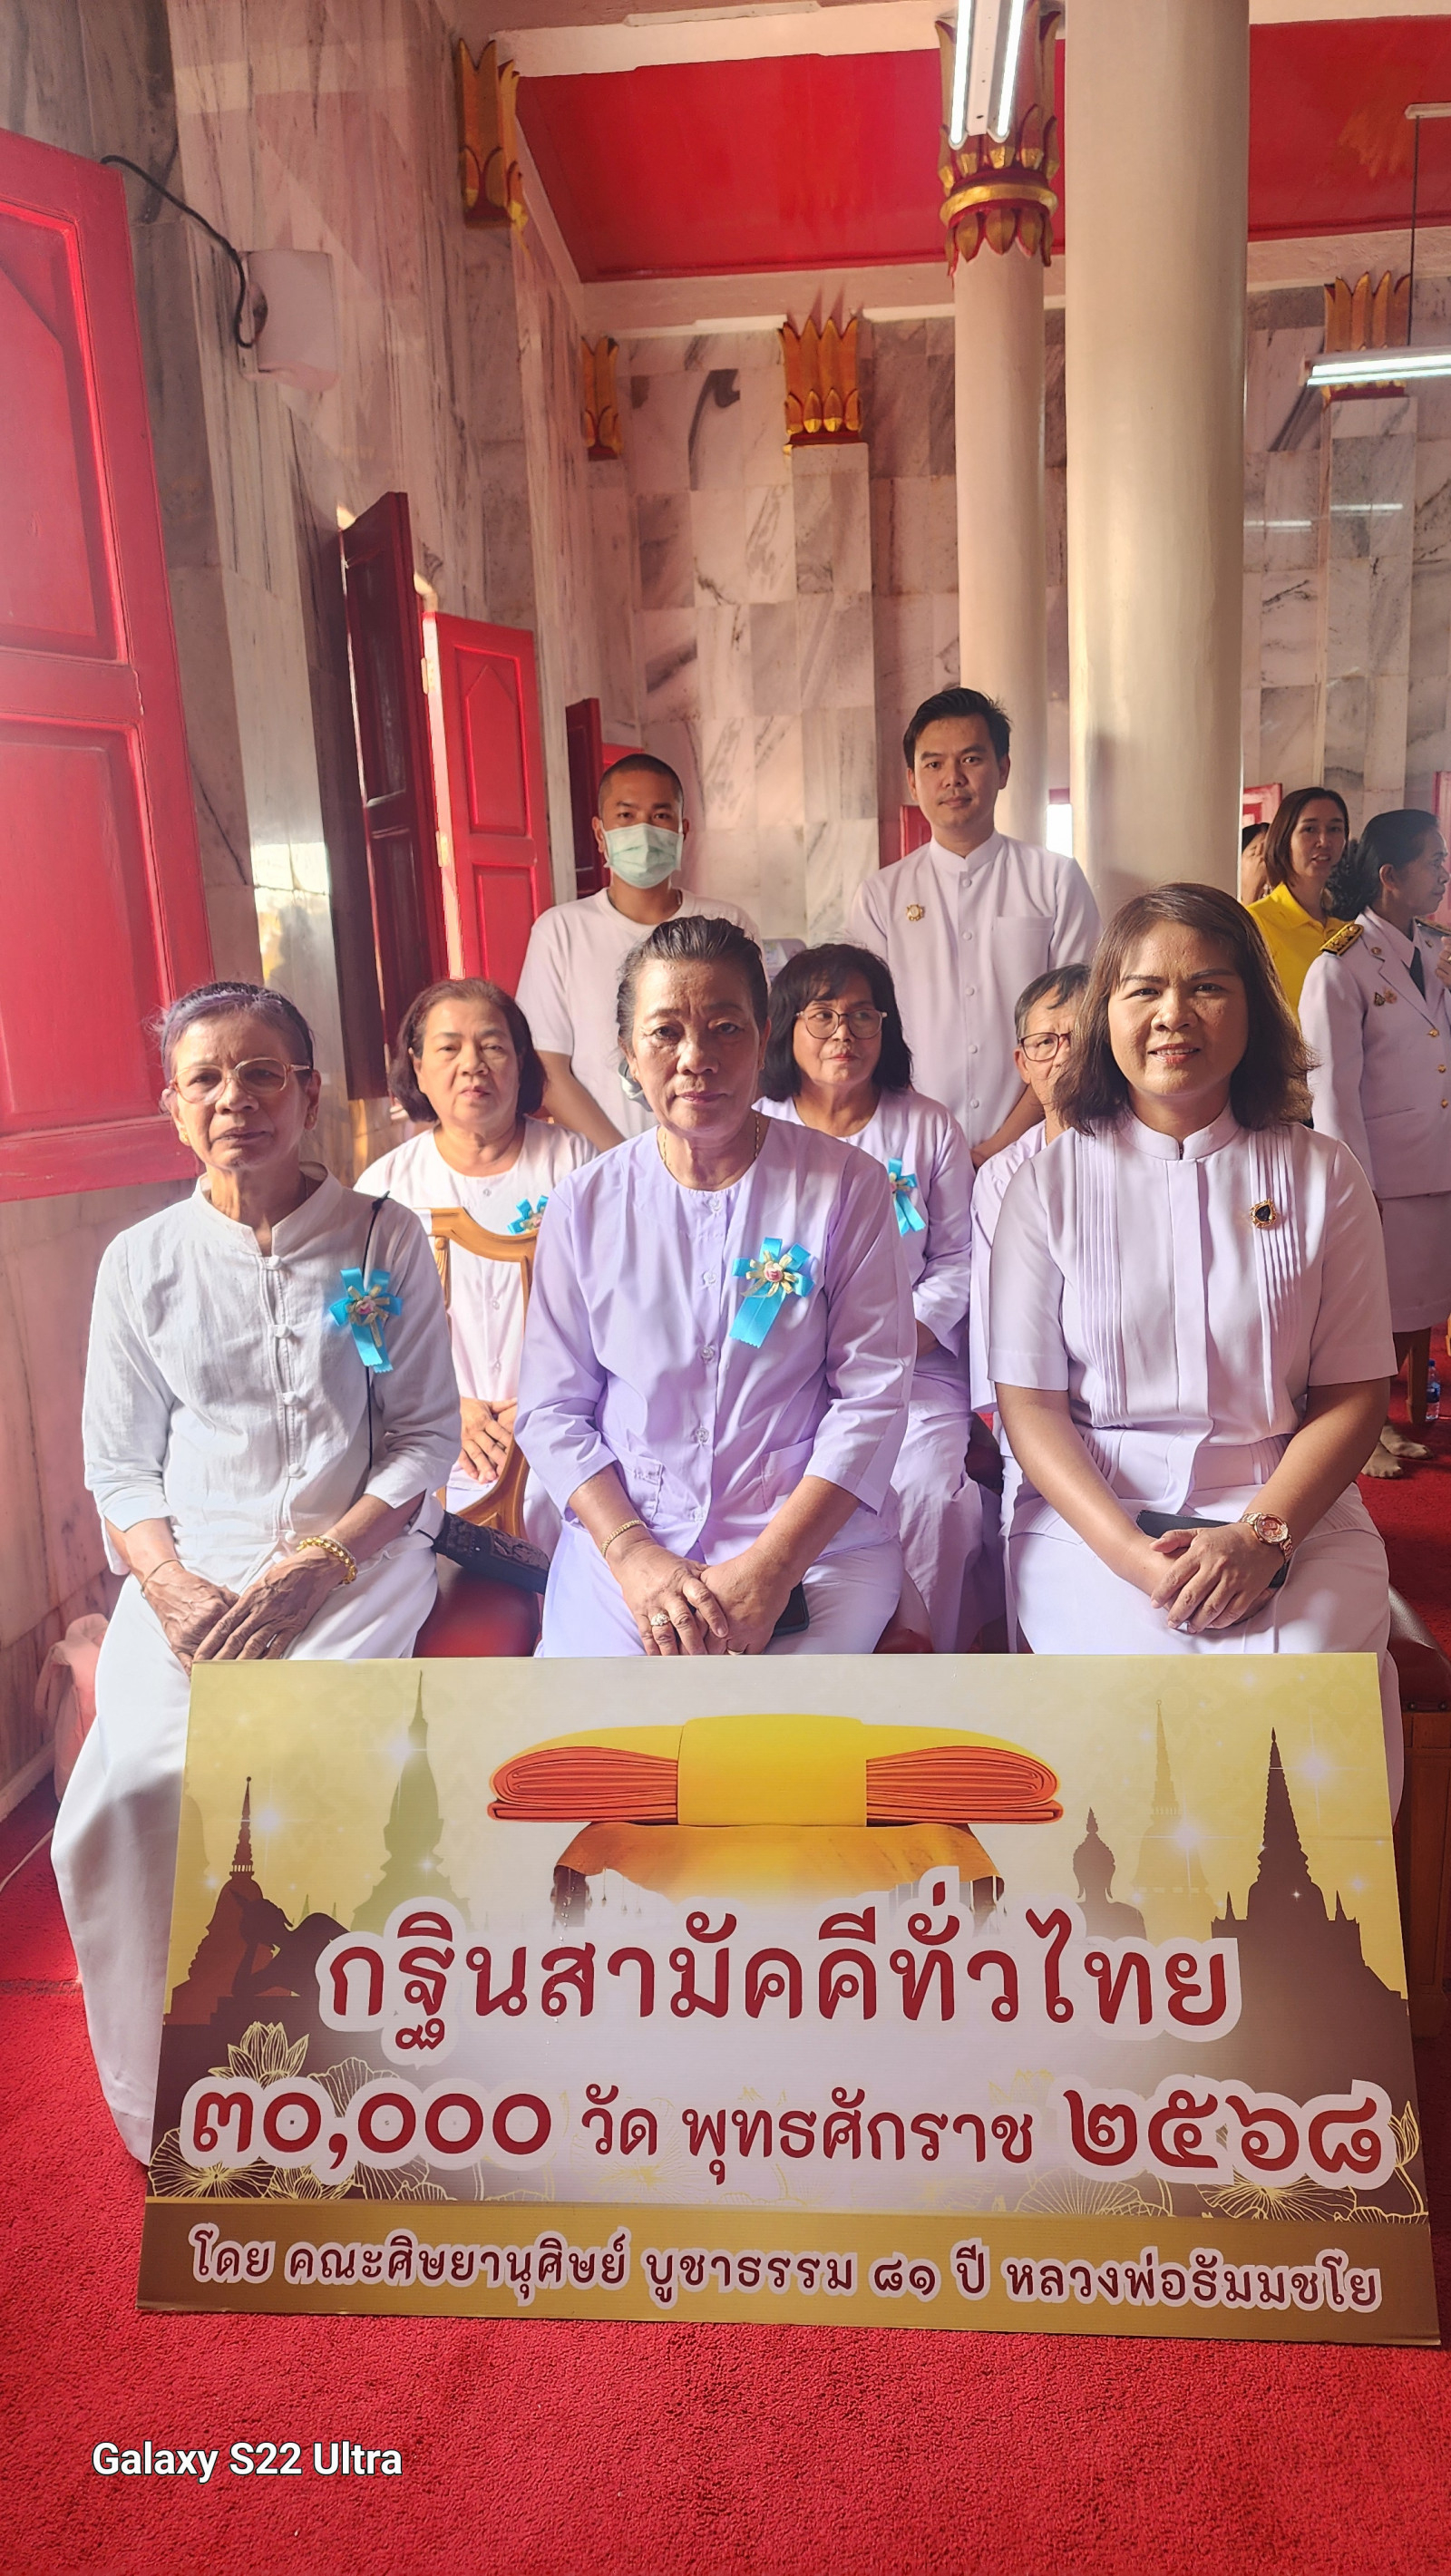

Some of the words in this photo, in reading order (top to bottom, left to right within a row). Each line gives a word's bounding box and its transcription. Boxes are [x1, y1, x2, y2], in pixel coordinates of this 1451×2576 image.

[329, 1881, 1229, 2050] กฐินสามัคคีทั่วไทย
[192, 2091, 551, 2169] ๓๐,๐๐๐
[581, 2084, 658, 2156] วัด
[682, 2086, 1033, 2185] พุทธศักราช
[1063, 2088, 1382, 2173] ๒๕๖๘
[194, 2229, 270, 2276] โดย
[289, 2233, 626, 2299] คณะศิษยานุศิษย์
[646, 2253, 852, 2303] บูชาธรรม
[873, 2259, 936, 2295] ๘๑
[956, 2244, 984, 2294] ปี
[1007, 2252, 1378, 2306] หลวงพ่อธัมมชโย
